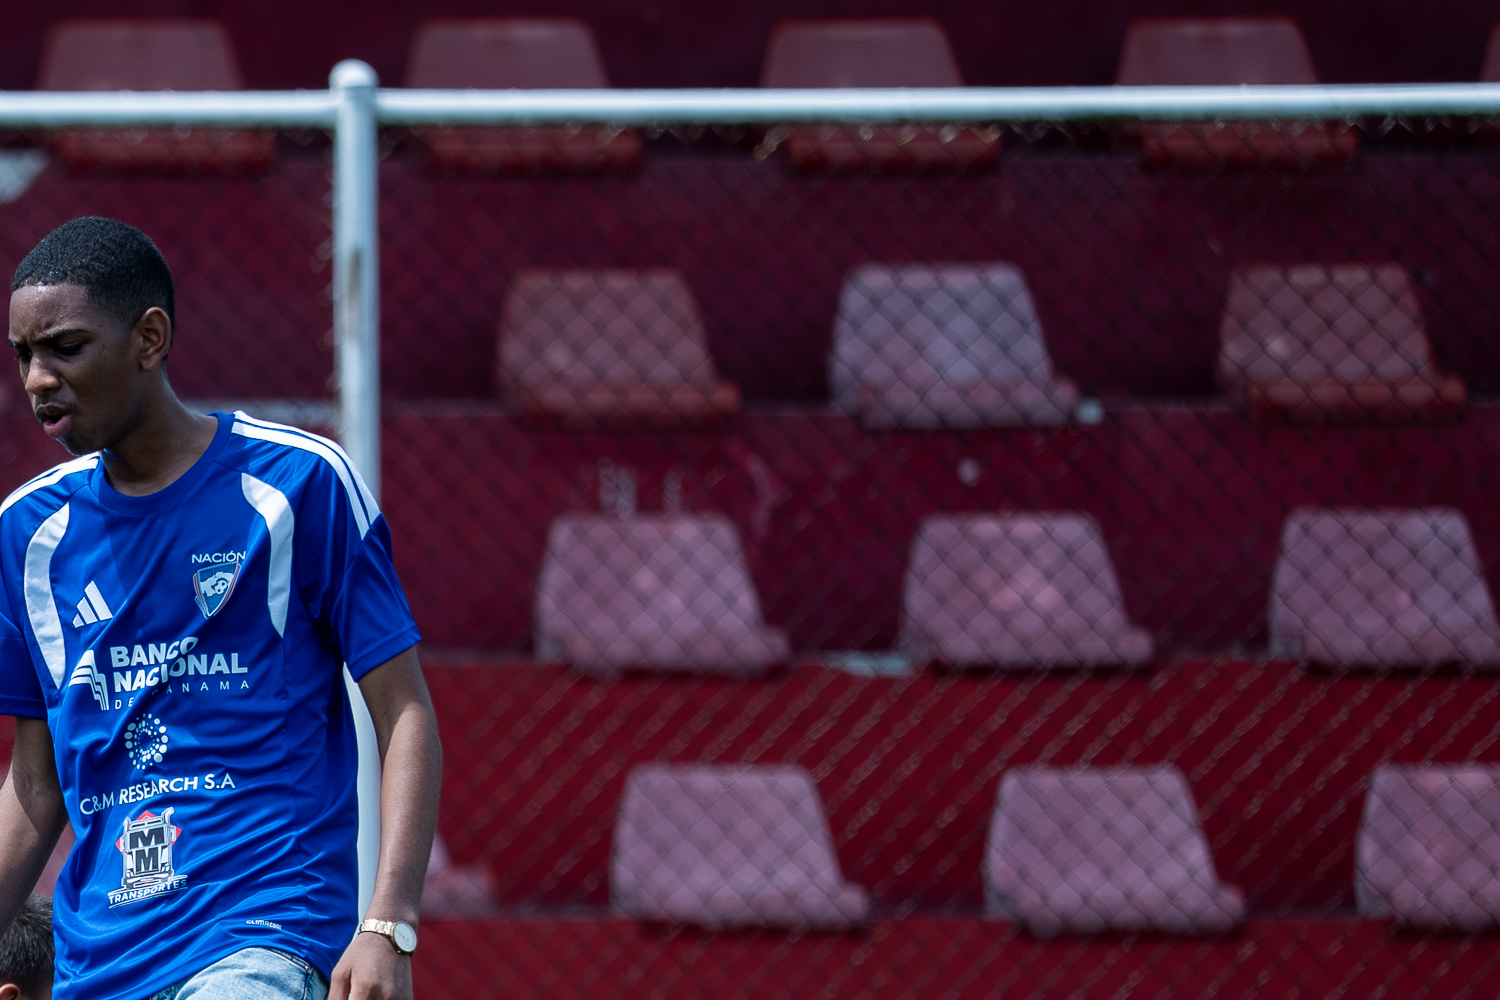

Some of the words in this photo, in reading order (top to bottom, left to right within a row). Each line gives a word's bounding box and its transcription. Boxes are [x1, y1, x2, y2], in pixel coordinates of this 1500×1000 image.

[191, 550, 247, 564] NACIÓN
[109, 636, 199, 668] BANCO
[113, 652, 249, 693] NACIONAL
[114, 697, 135, 710] DE
[152, 680, 250, 696] ANAMA
[79, 791, 115, 815] C&M
[118, 776, 199, 805] RESEARCH
[203, 772, 236, 790] S.A
[108, 879, 187, 905] TRANSPORTES
